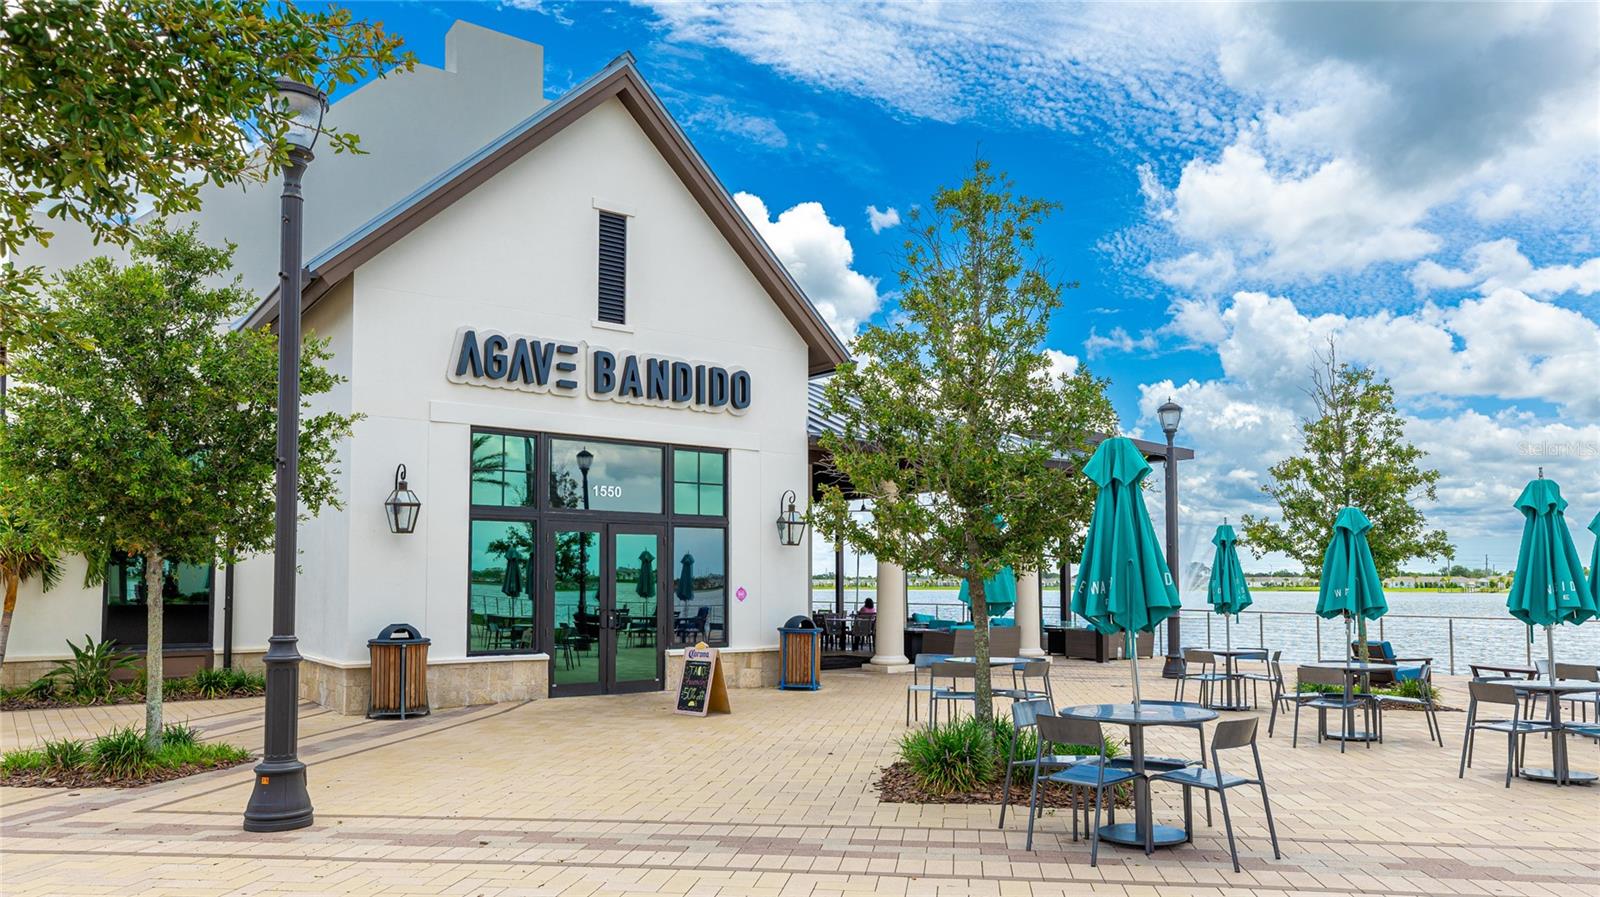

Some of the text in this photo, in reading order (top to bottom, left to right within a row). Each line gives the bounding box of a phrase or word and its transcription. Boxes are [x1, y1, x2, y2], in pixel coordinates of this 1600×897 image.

[456, 330, 751, 410] AGAVE BANDIDO
[592, 485, 622, 498] 1550
[688, 649, 709, 659] Corona
